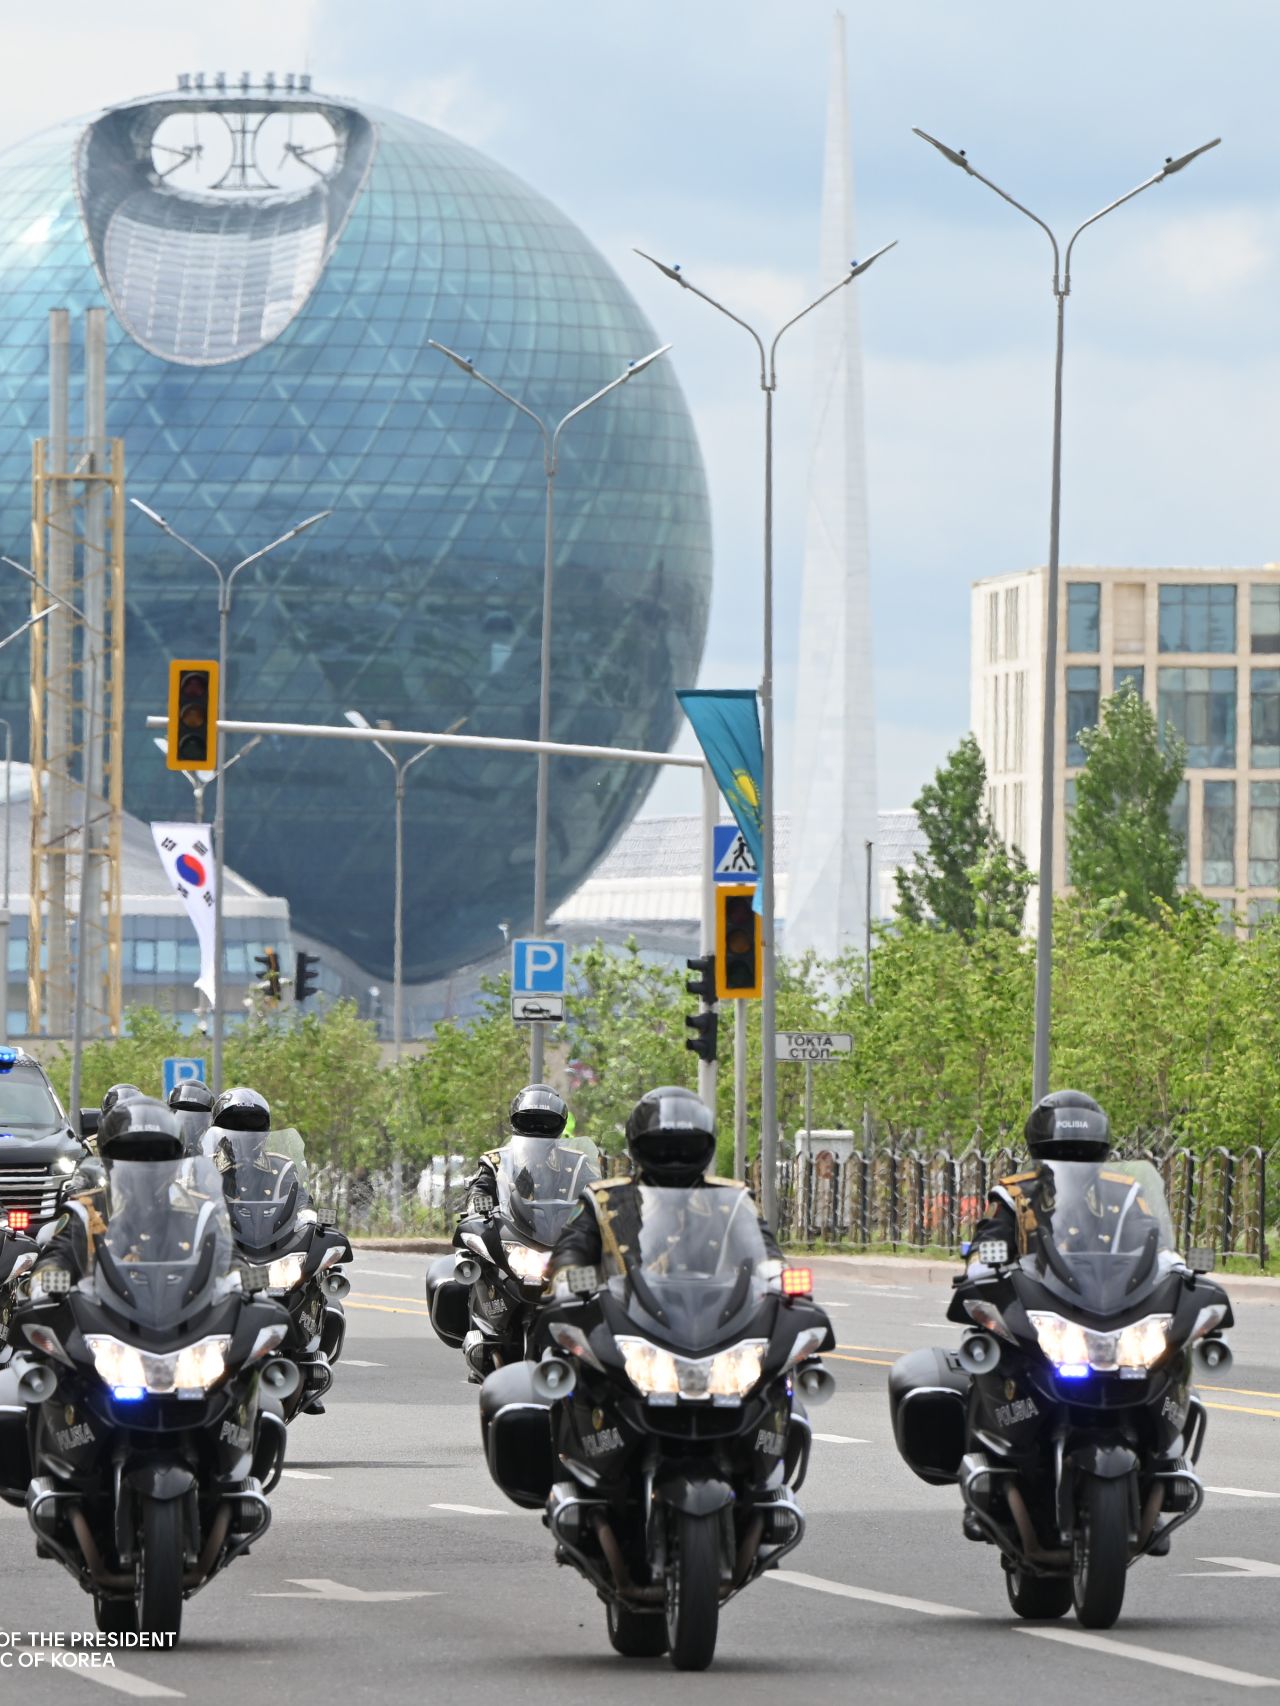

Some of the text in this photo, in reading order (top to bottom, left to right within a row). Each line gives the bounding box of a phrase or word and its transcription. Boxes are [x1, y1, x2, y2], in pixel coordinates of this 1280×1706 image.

[525, 945, 557, 989] P
[790, 1047, 831, 1058] СТОП
[1056, 1120, 1089, 1129] POLISIA
